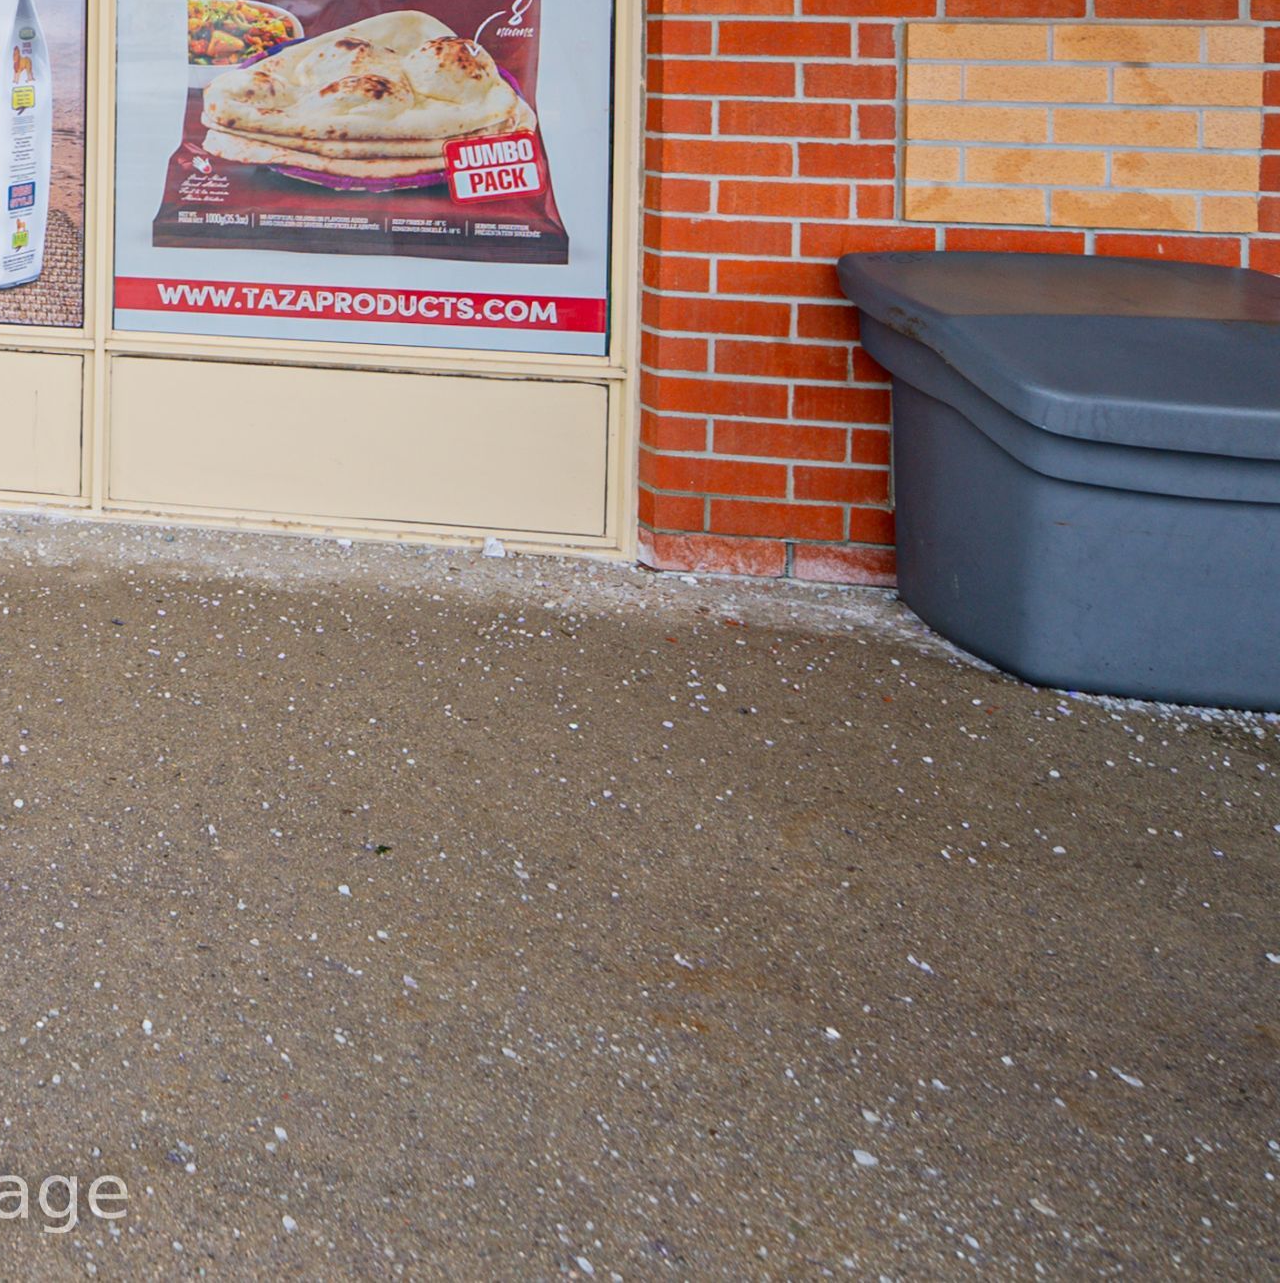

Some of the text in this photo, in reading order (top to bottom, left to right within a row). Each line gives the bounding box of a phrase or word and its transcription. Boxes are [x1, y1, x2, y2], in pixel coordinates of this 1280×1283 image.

[496, 26, 535, 37] naans
[453, 138, 535, 169] JUMBO
[468, 166, 529, 194] PACK
[156, 282, 559, 324] WWW.TAZAPRODUCTS.COM
